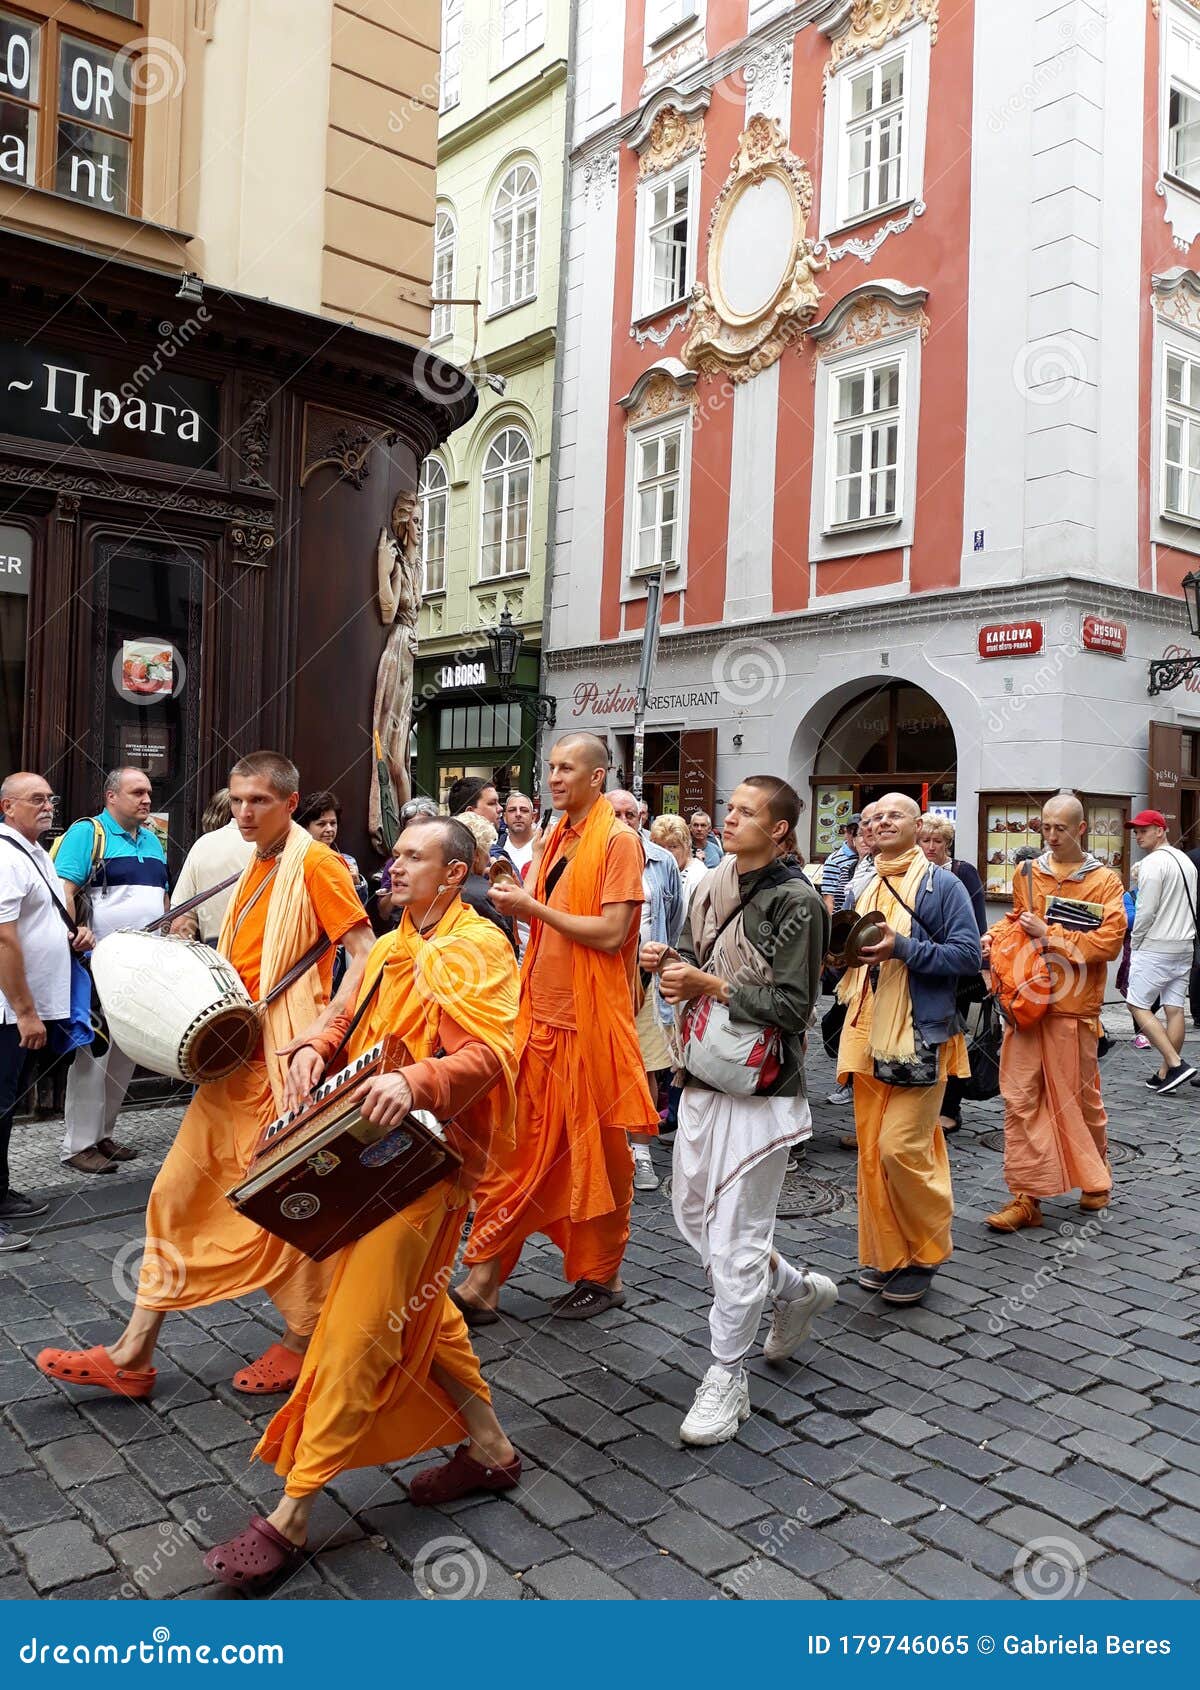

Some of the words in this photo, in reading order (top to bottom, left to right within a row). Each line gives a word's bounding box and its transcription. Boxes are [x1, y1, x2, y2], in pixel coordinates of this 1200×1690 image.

[40, 363, 200, 443] Прага
[986, 628, 1033, 644] KARLOVA
[1094, 623, 1121, 639] HUSOVA
[441, 666, 454, 688] LA
[455, 662, 487, 687] BORSA
[572, 682, 639, 717] Puškin
[648, 691, 720, 710] RESTAURANT
